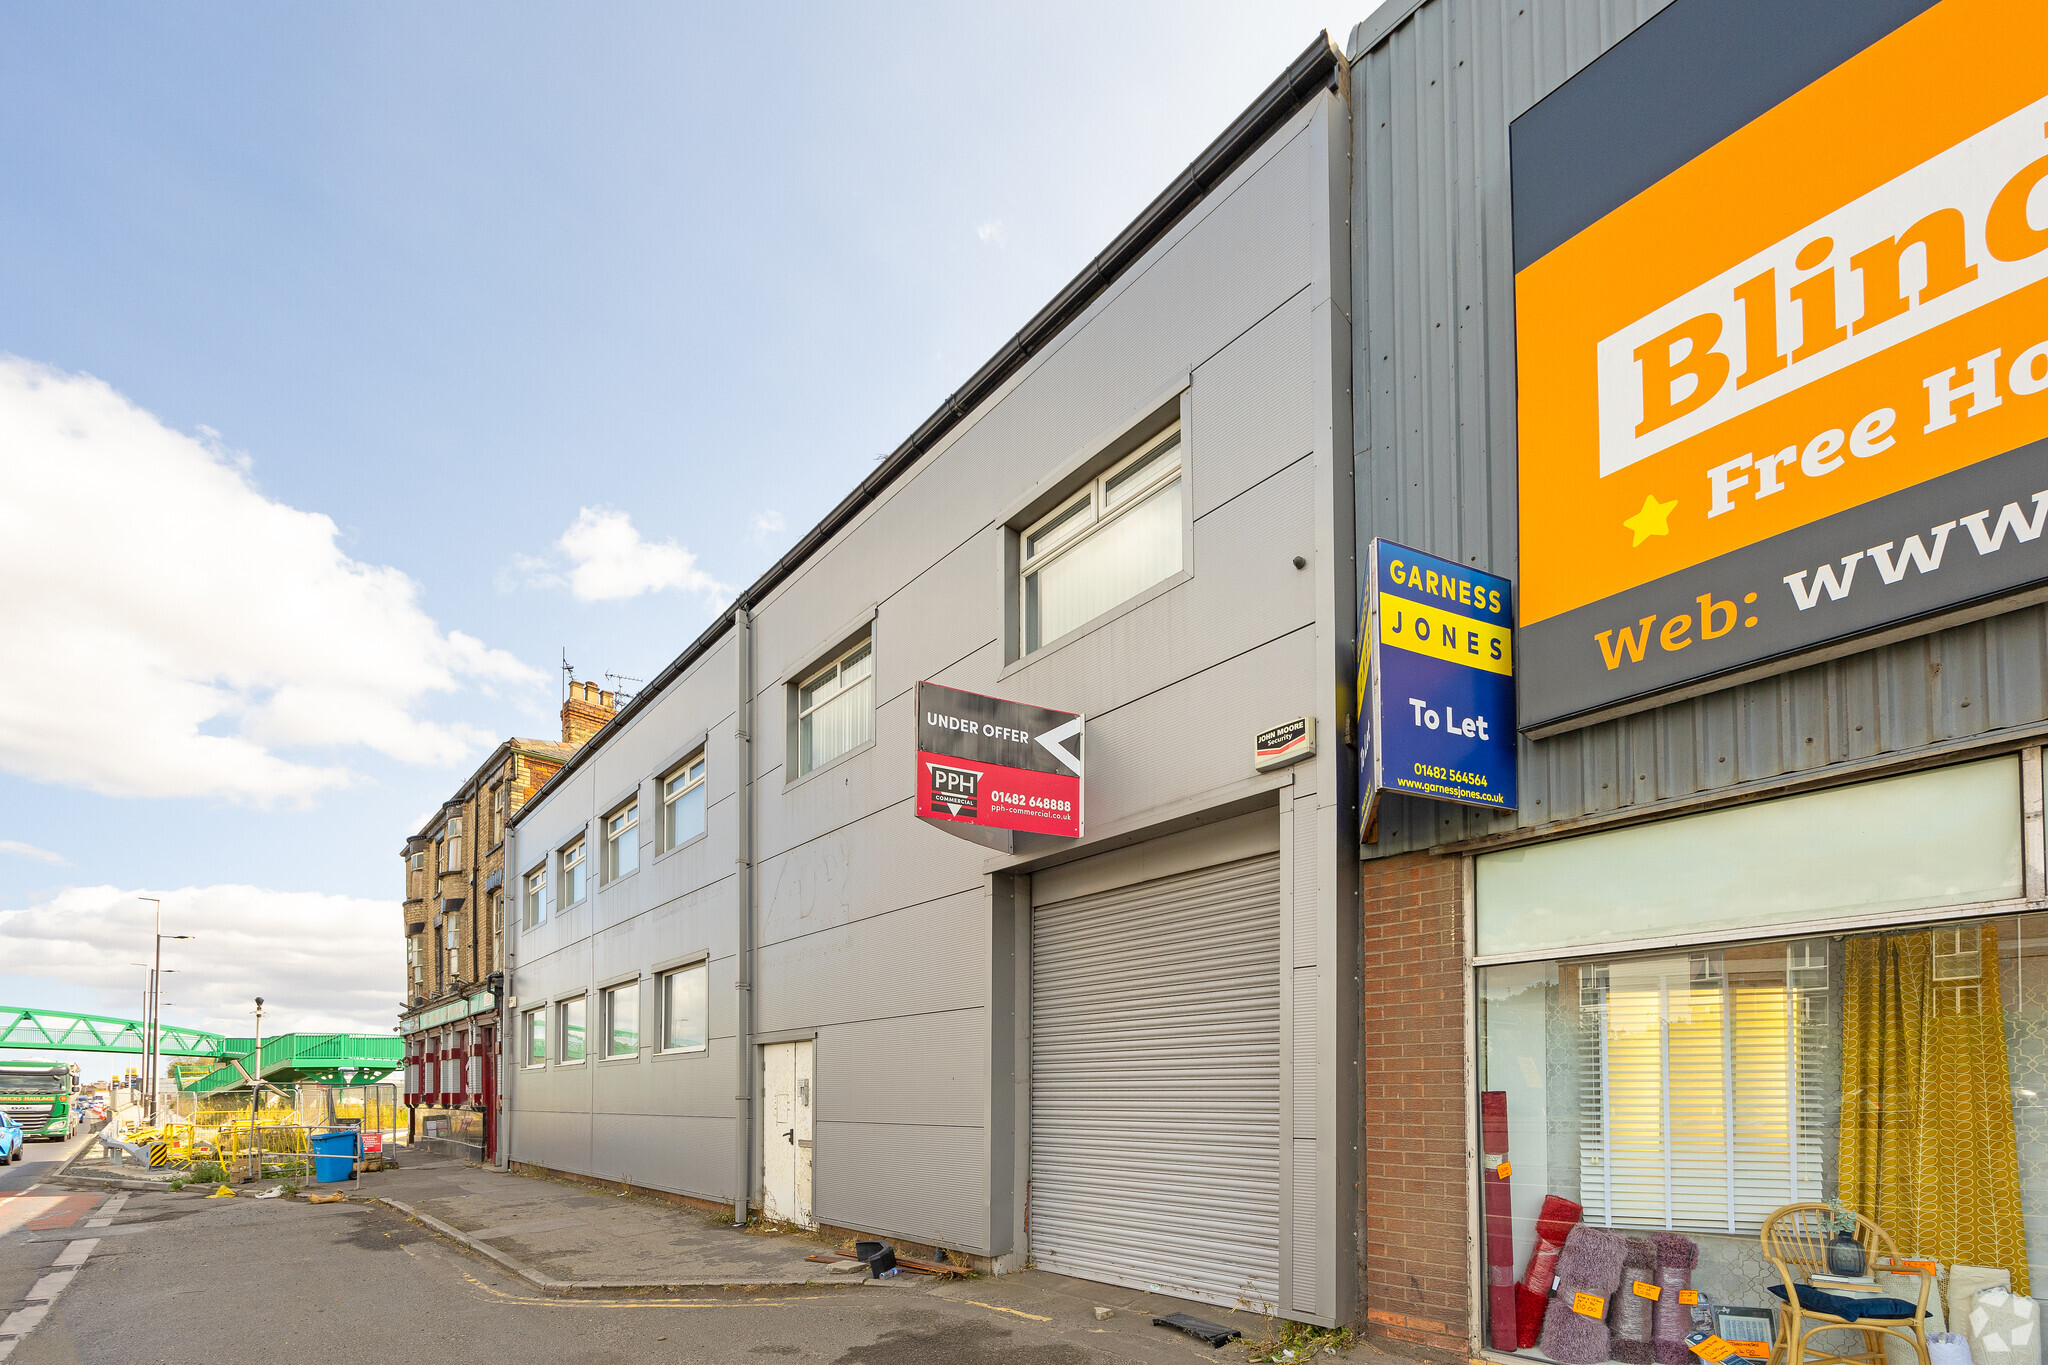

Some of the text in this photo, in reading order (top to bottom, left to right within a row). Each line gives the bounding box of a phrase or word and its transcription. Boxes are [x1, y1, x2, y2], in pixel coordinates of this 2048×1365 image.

[1707, 406, 1896, 519] Free
[1389, 559, 1502, 614] GARNESS
[1391, 610, 1502, 661] JONES
[1595, 590, 1760, 671] Web:
[927, 712, 1029, 744] UNDER OFFER
[1408, 697, 1489, 741] To Let
[1258, 721, 1304, 744] JOHN MOORE
[1267, 733, 1293, 747] Security
[935, 770, 974, 794] PPH
[1414, 762, 1488, 788] 01482 564564
[935, 795, 974, 806] COMMERCIAL
[991, 790, 1071, 812] 01482 648888
[1397, 777, 1504, 804] www.garnessjones.co.uk
[991, 806, 1071, 821] pph-commercial.co.uk
